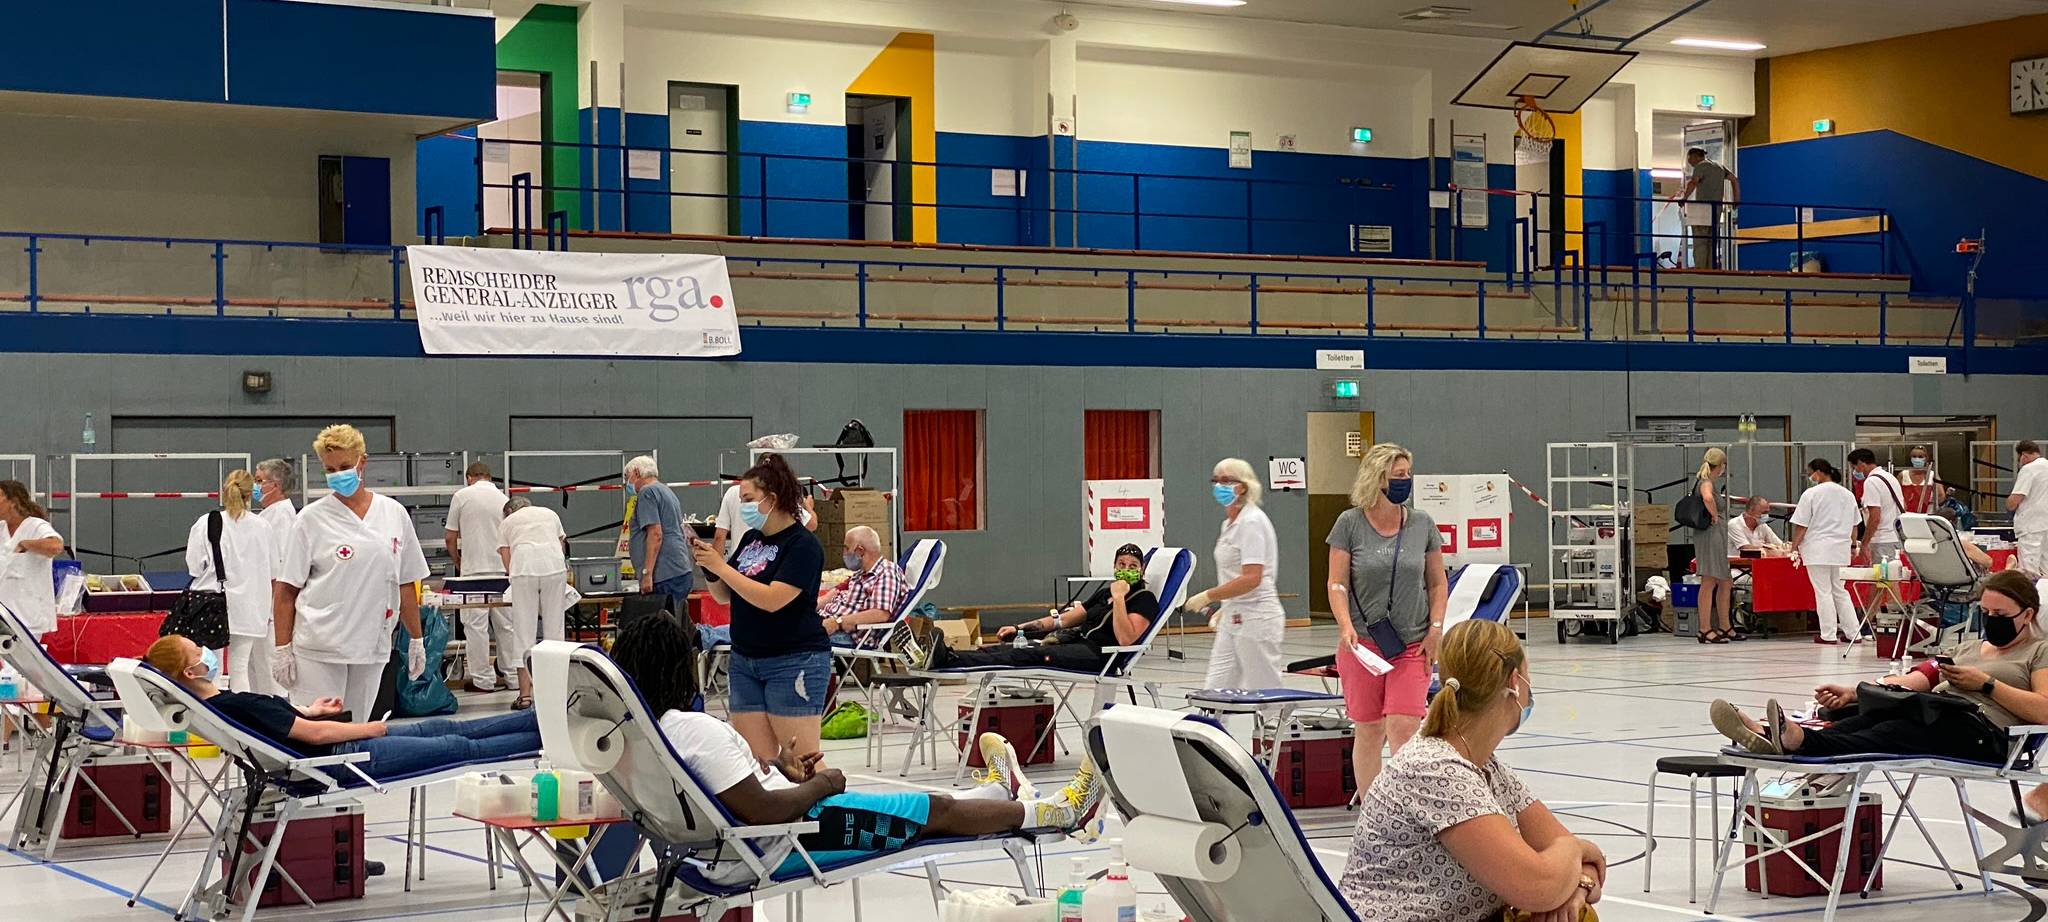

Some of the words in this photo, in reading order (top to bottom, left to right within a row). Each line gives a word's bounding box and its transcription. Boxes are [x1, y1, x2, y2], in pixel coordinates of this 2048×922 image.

[422, 267, 557, 290] REMSCHEIDER
[424, 285, 618, 309] GENERAL-ANZEIGER
[474, 312, 495, 322] wir
[500, 312, 525, 323] hier
[531, 315, 545, 323] zu
[551, 314, 589, 324] Hause
[593, 314, 624, 325] sind!
[445, 460, 451, 469] 5
[1279, 461, 1297, 475] WC
